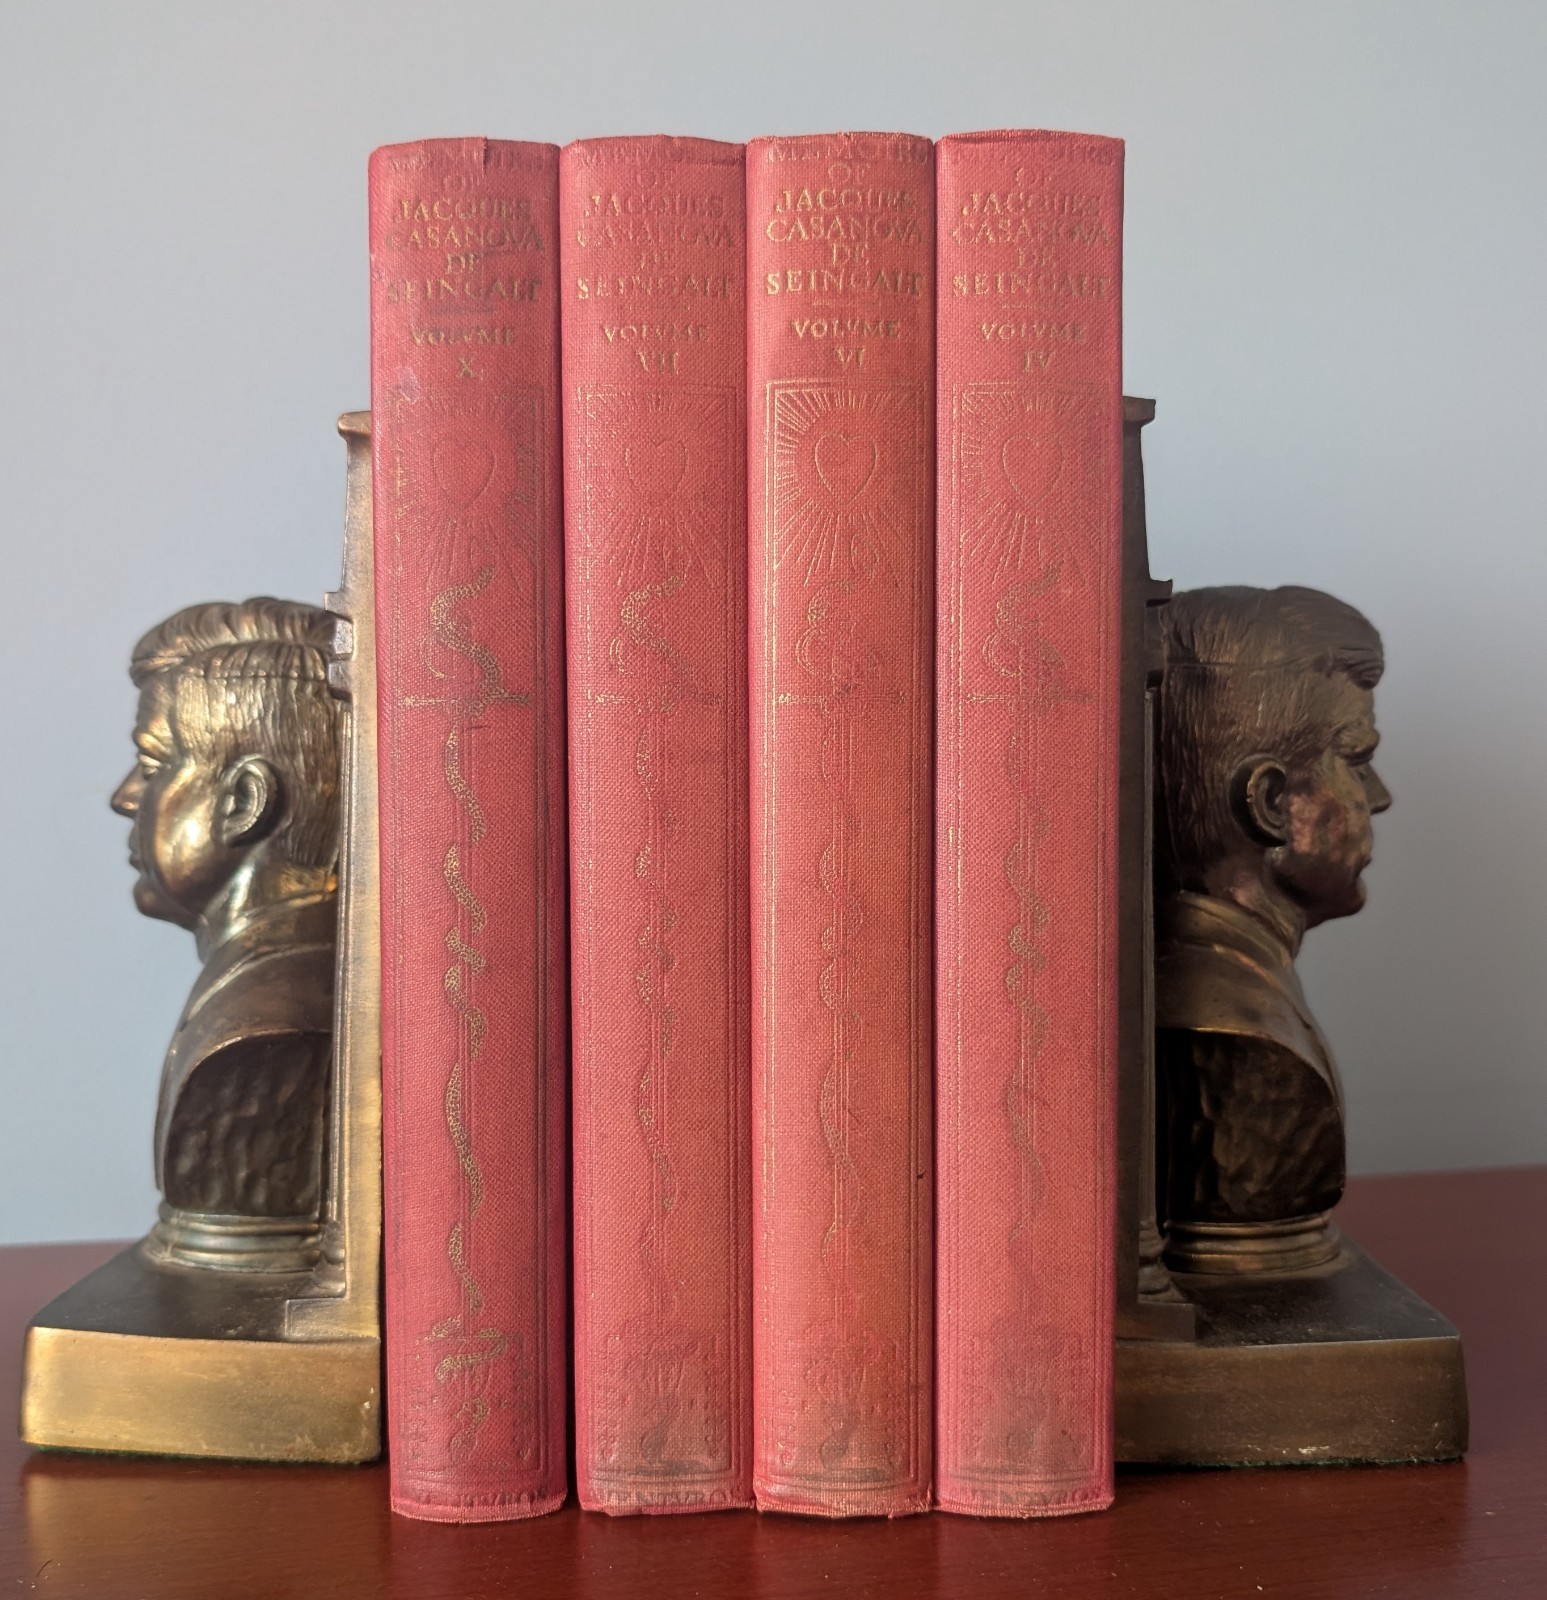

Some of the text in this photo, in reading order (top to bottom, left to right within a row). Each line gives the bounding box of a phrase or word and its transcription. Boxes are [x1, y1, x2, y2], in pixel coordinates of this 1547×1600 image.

[776, 190, 916, 213] JACQUES
[766, 217, 924, 242] CASANOVA
[831, 244, 869, 266] DE
[767, 270, 923, 295] SEINGALT
[458, 358, 475, 378] X
[636, 352, 679, 375] VII
[834, 348, 865, 368] VI
[1023, 351, 1055, 372] IV
